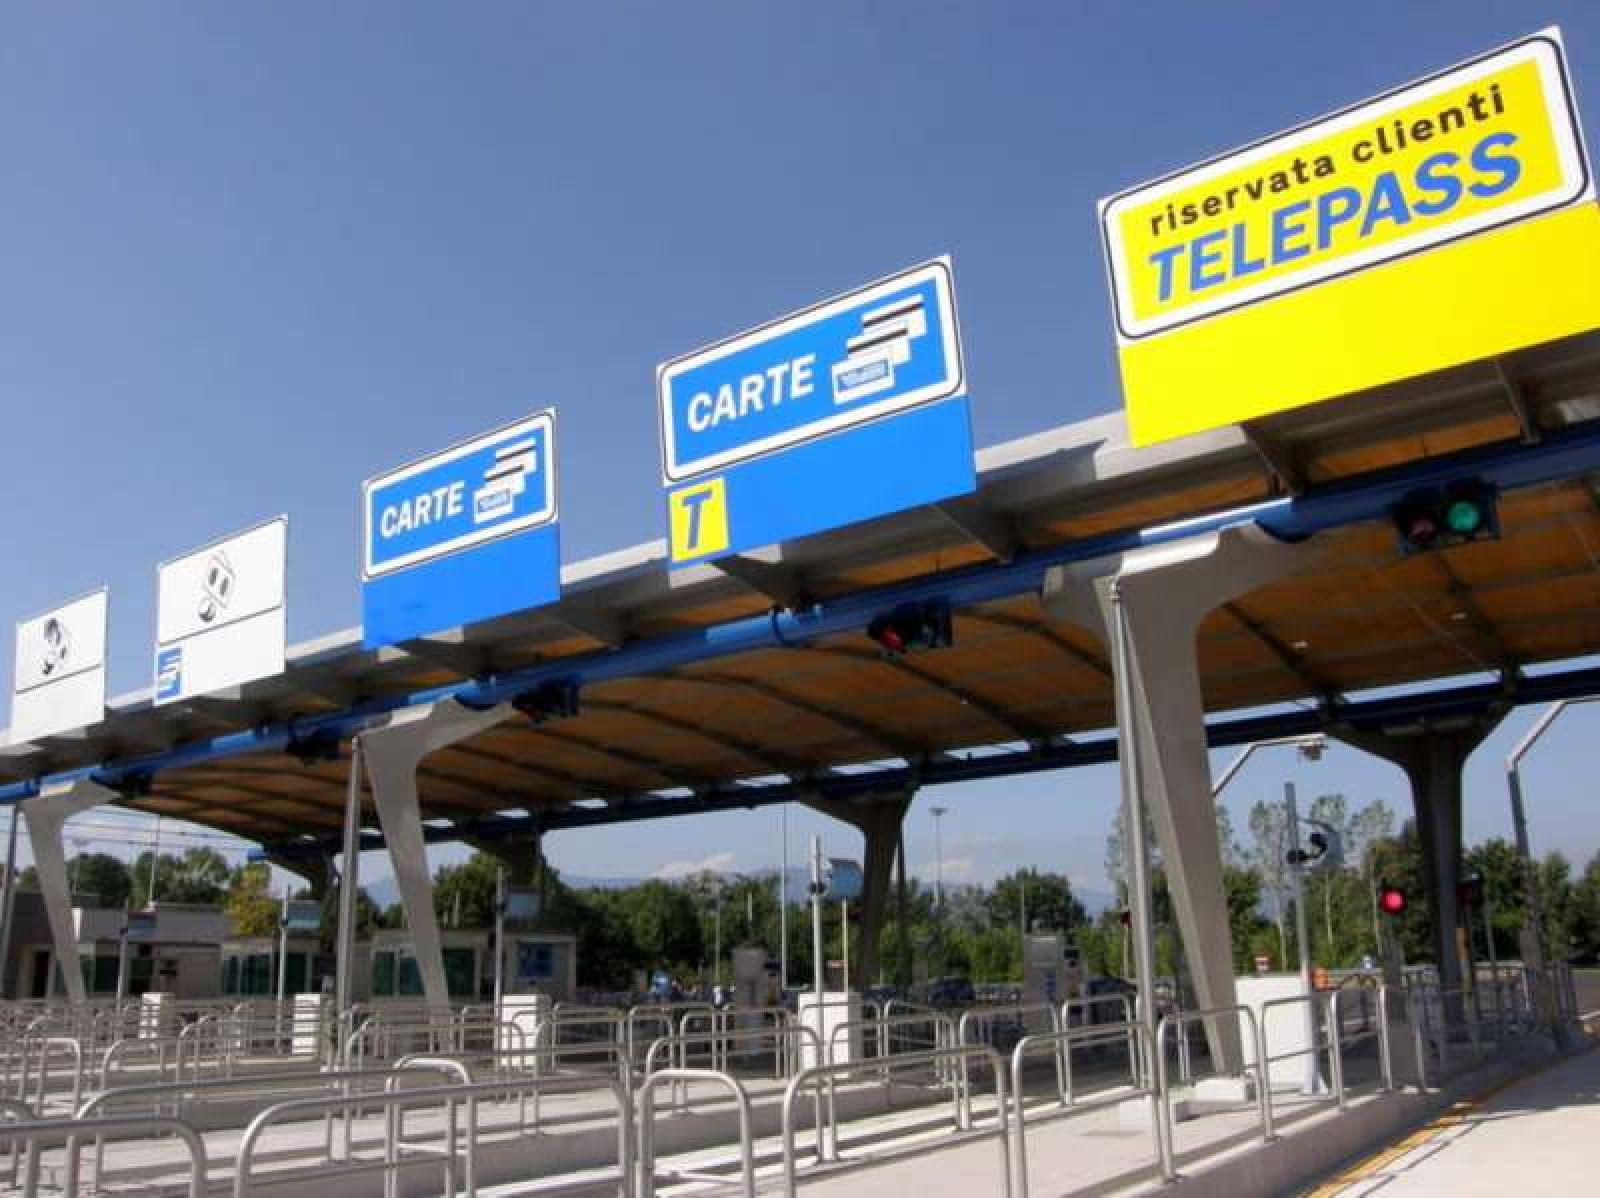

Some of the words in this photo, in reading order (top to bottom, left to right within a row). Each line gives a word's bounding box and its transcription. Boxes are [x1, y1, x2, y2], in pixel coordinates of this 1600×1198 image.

[1150, 152, 1336, 236] riservata
[1351, 84, 1505, 163] clienti
[1149, 132, 1522, 302] TELEPASS
[687, 353, 817, 432] CARTE
[381, 480, 465, 538] CARTE
[680, 487, 714, 551] T
